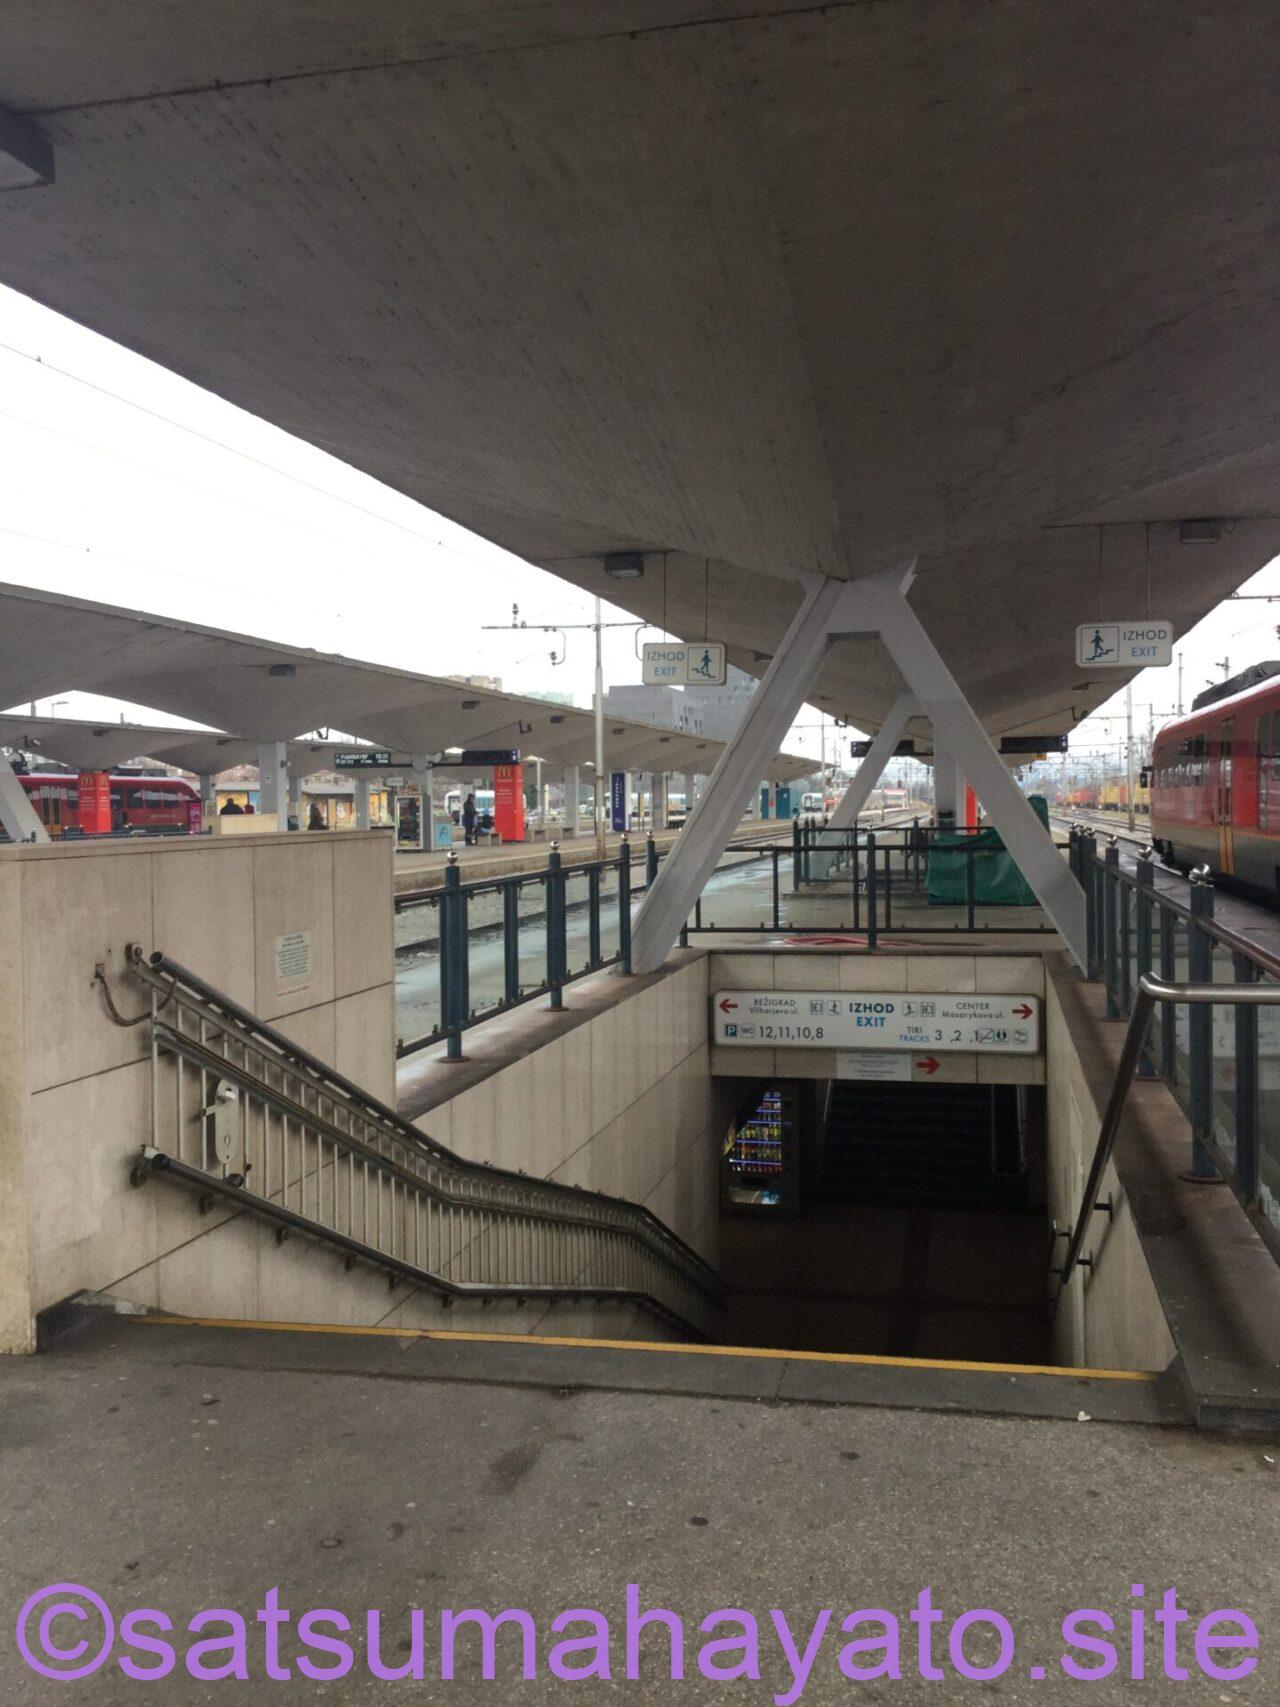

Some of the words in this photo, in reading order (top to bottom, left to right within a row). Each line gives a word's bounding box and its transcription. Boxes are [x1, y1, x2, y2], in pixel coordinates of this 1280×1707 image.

[1123, 629, 1167, 641] IZHOD
[647, 651, 685, 661] IZHOD
[1131, 646, 1158, 657] EXIT
[655, 666, 677, 677] EXIT
[753, 997, 796, 1006] BEŽIGRAD
[956, 1002, 990, 1010] CENTER
[849, 1002, 895, 1014] IZHOD
[856, 1016, 886, 1027] EXIT
[741, 1026, 754, 1034] WC
[906, 1026, 923, 1034] TIRI
[899, 1034, 930, 1043] TRACKS
